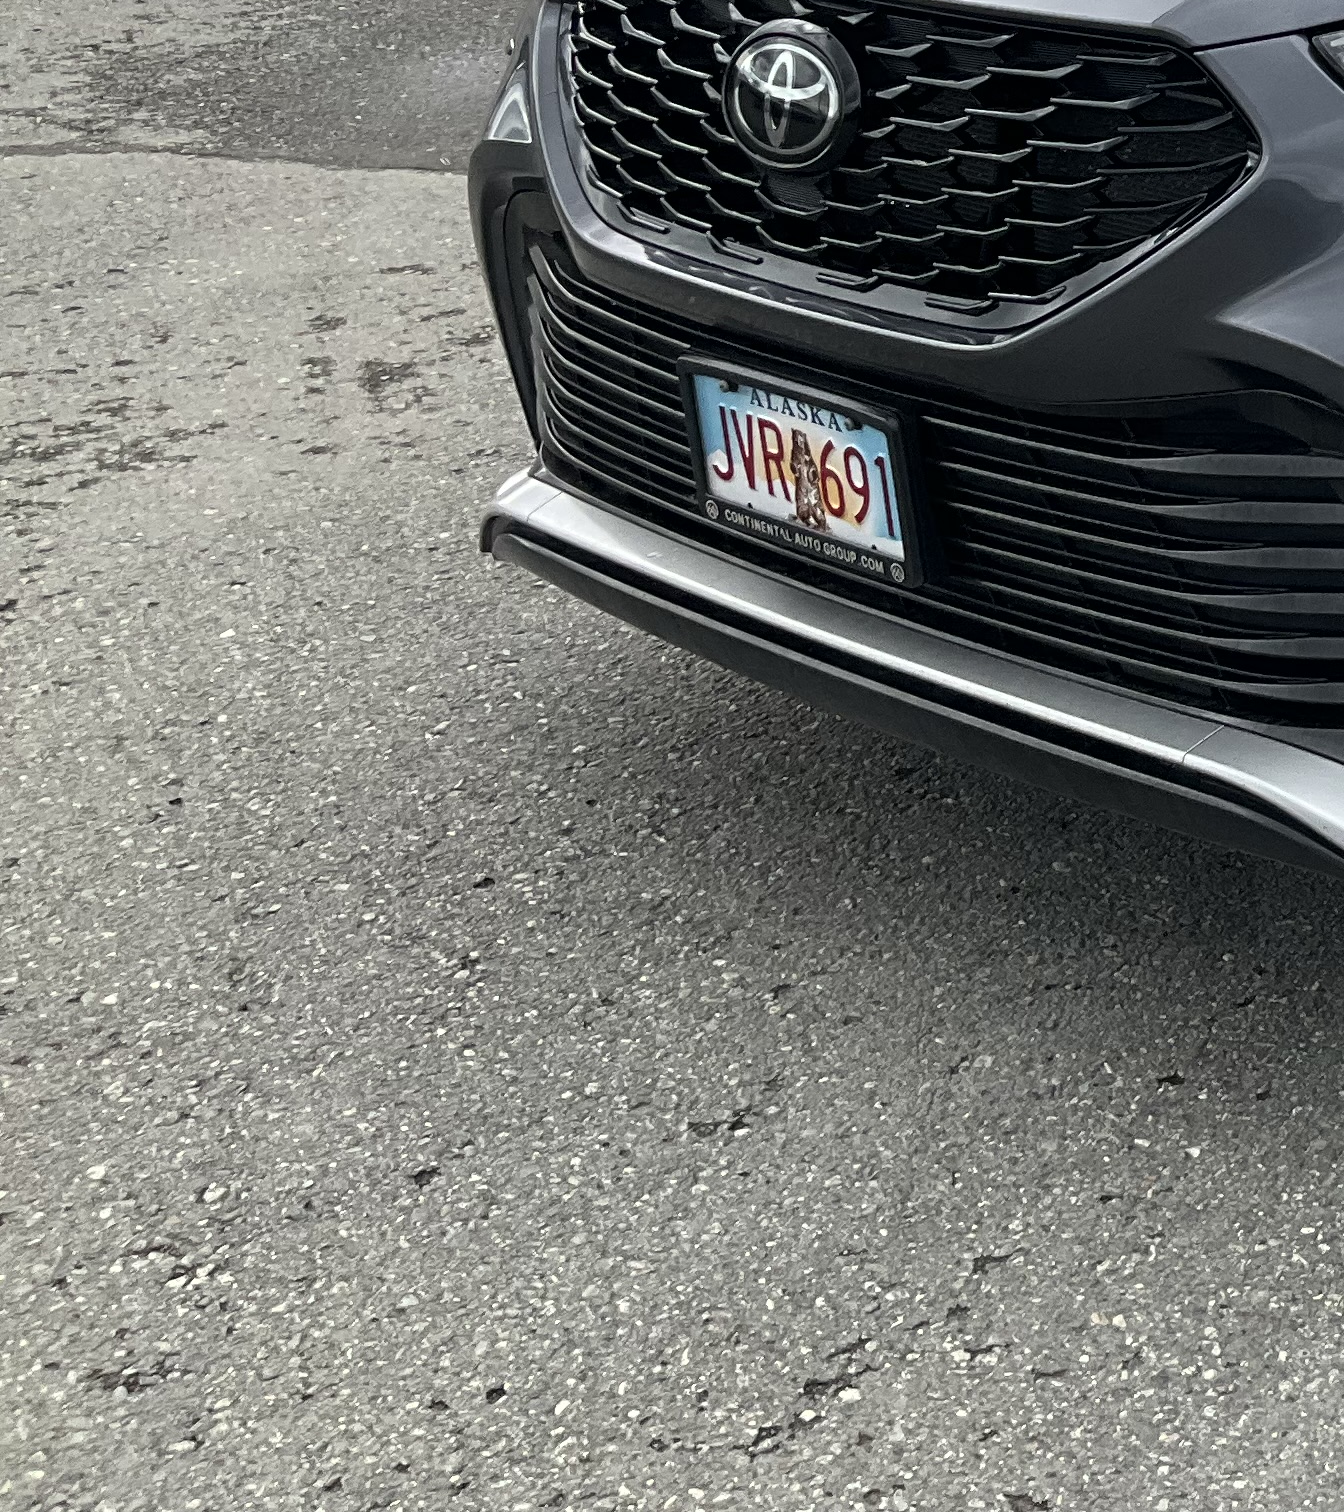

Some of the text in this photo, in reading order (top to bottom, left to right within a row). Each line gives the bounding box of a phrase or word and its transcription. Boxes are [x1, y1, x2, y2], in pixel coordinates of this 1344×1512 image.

[750, 387, 843, 433] ALASKA
[712, 405, 895, 537] JVR 691
[724, 508, 793, 543] CONTINENTAL
[794, 532, 821, 553] AUTO
[823, 542, 857, 564] GROUP
